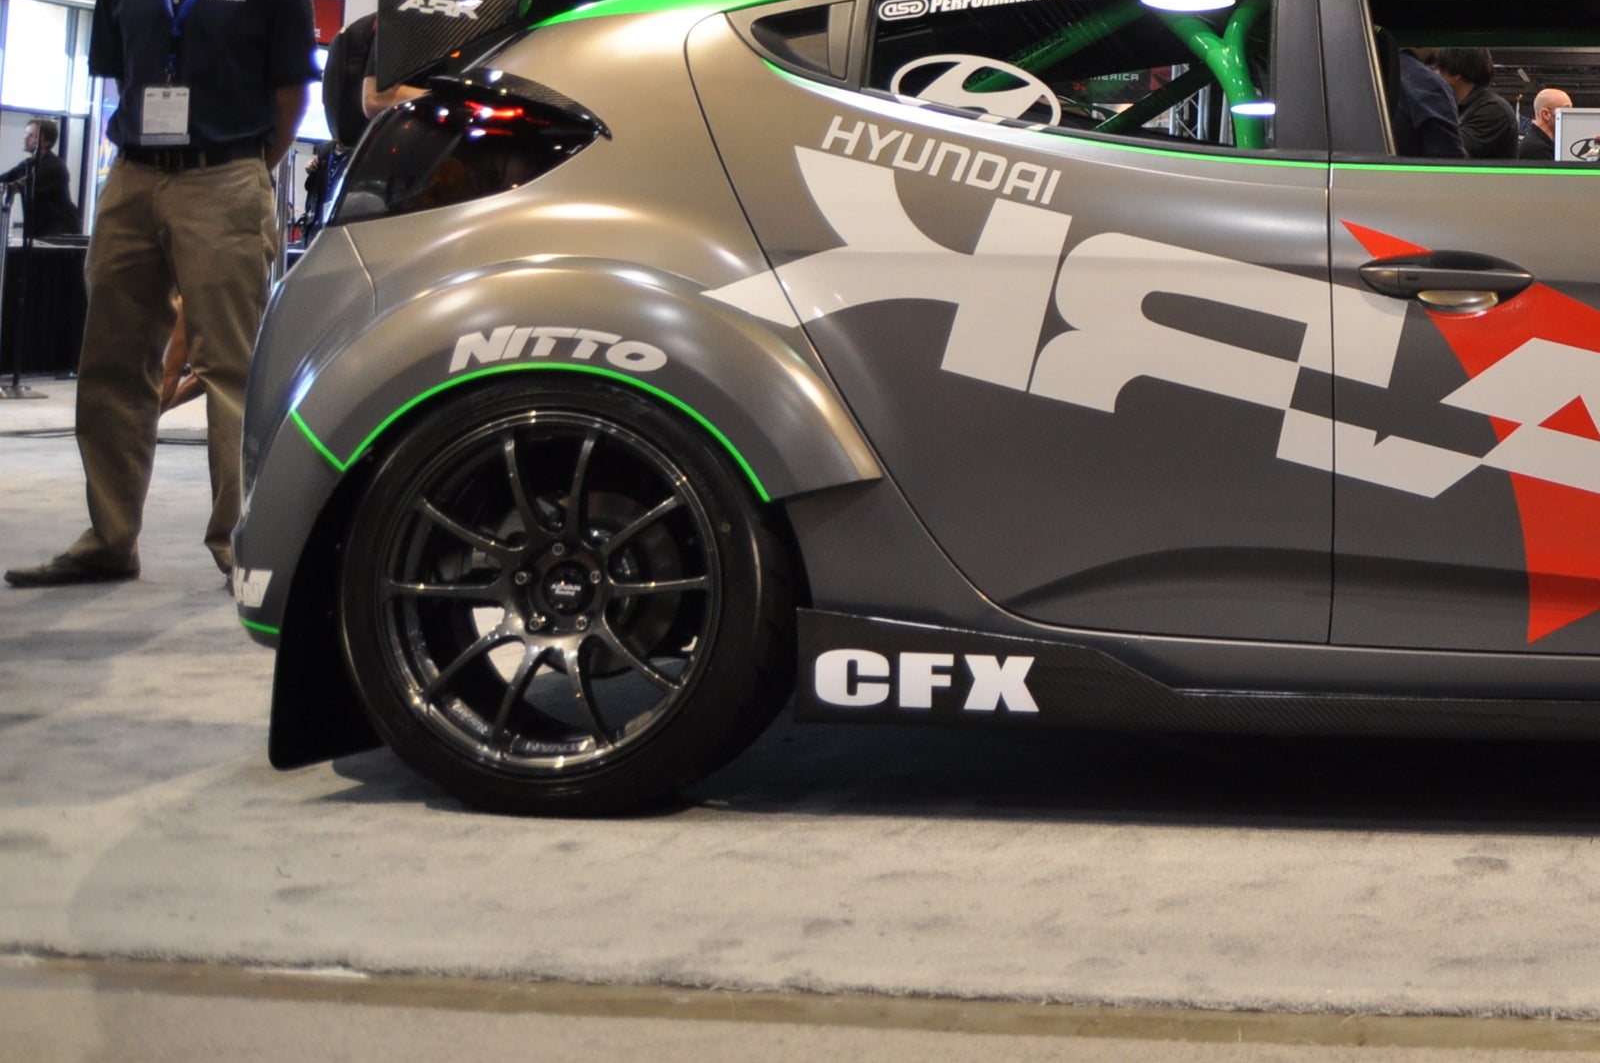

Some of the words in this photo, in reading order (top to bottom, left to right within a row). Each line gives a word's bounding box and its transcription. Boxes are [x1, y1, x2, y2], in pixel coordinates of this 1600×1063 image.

[821, 115, 1062, 205] HYUNDAI
[448, 325, 668, 373] NITTO
[814, 648, 1040, 713] CFX
